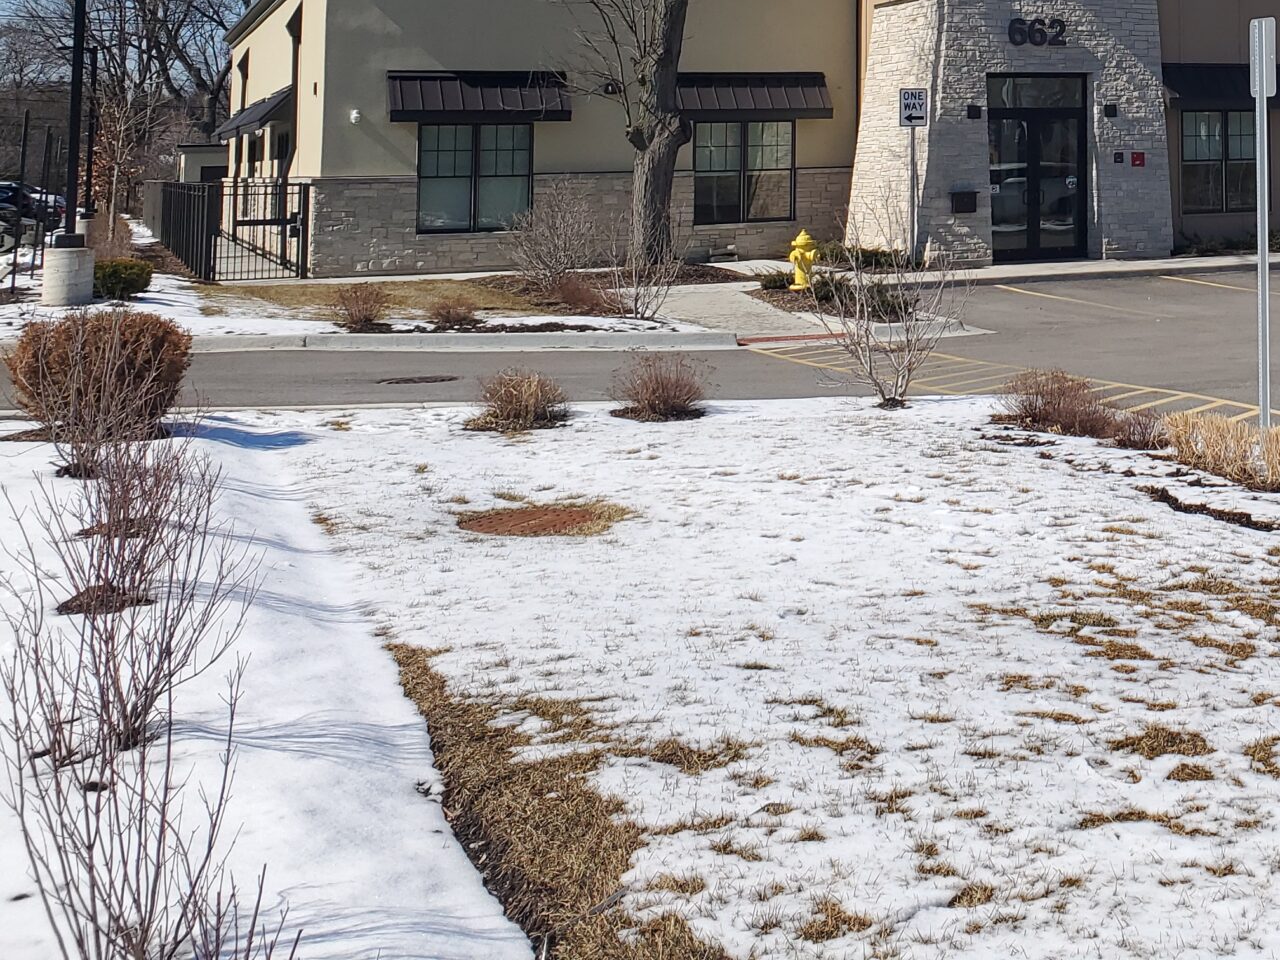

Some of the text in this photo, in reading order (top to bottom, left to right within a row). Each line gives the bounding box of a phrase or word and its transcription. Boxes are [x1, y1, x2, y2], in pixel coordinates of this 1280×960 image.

[1008, 18, 1067, 46] 662
[903, 91, 924, 101] ONE
[904, 101, 925, 112] WAY
